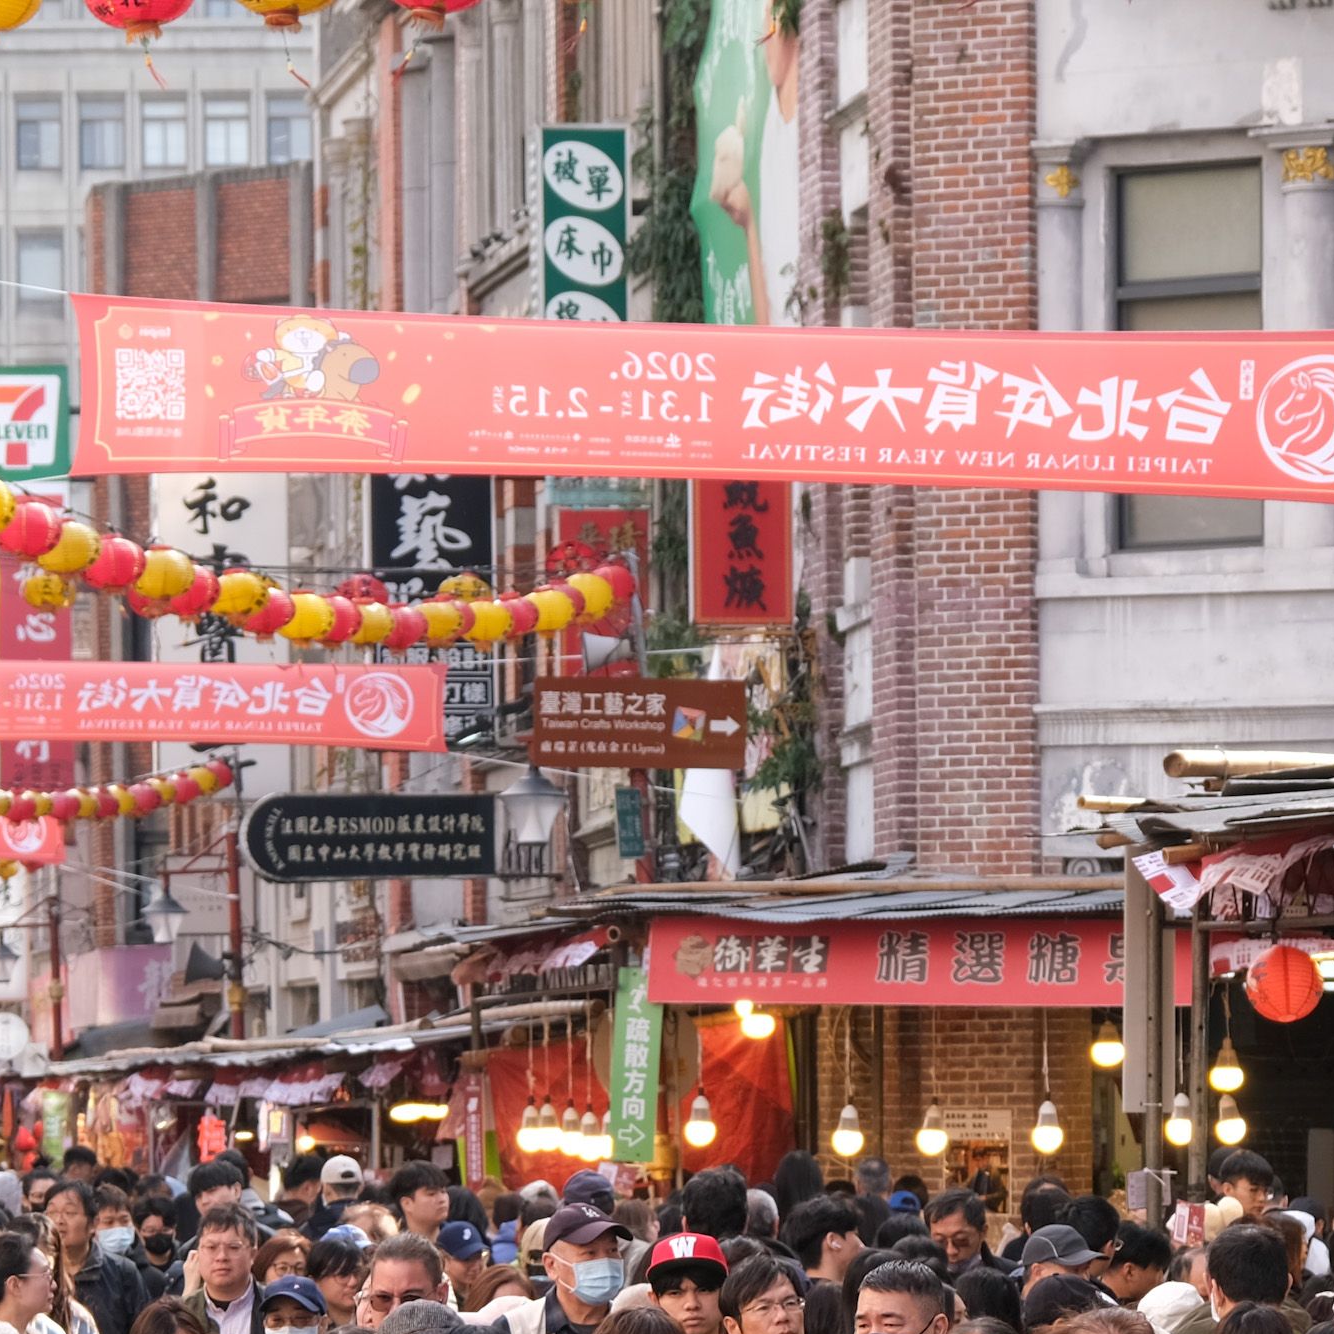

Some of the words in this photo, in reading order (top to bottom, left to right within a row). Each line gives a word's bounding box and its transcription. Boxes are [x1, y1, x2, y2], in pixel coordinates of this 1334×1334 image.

[553, 148, 612, 202] 被單
[539, 690, 667, 716] 臺灣工藝之家
[542, 718, 578, 731] Taiwan
[579, 718, 613, 731] Crafts
[616, 719, 666, 734] Workshop
[621, 1016, 651, 1121] 疏散方向
[668, 1236, 697, 1259] W
